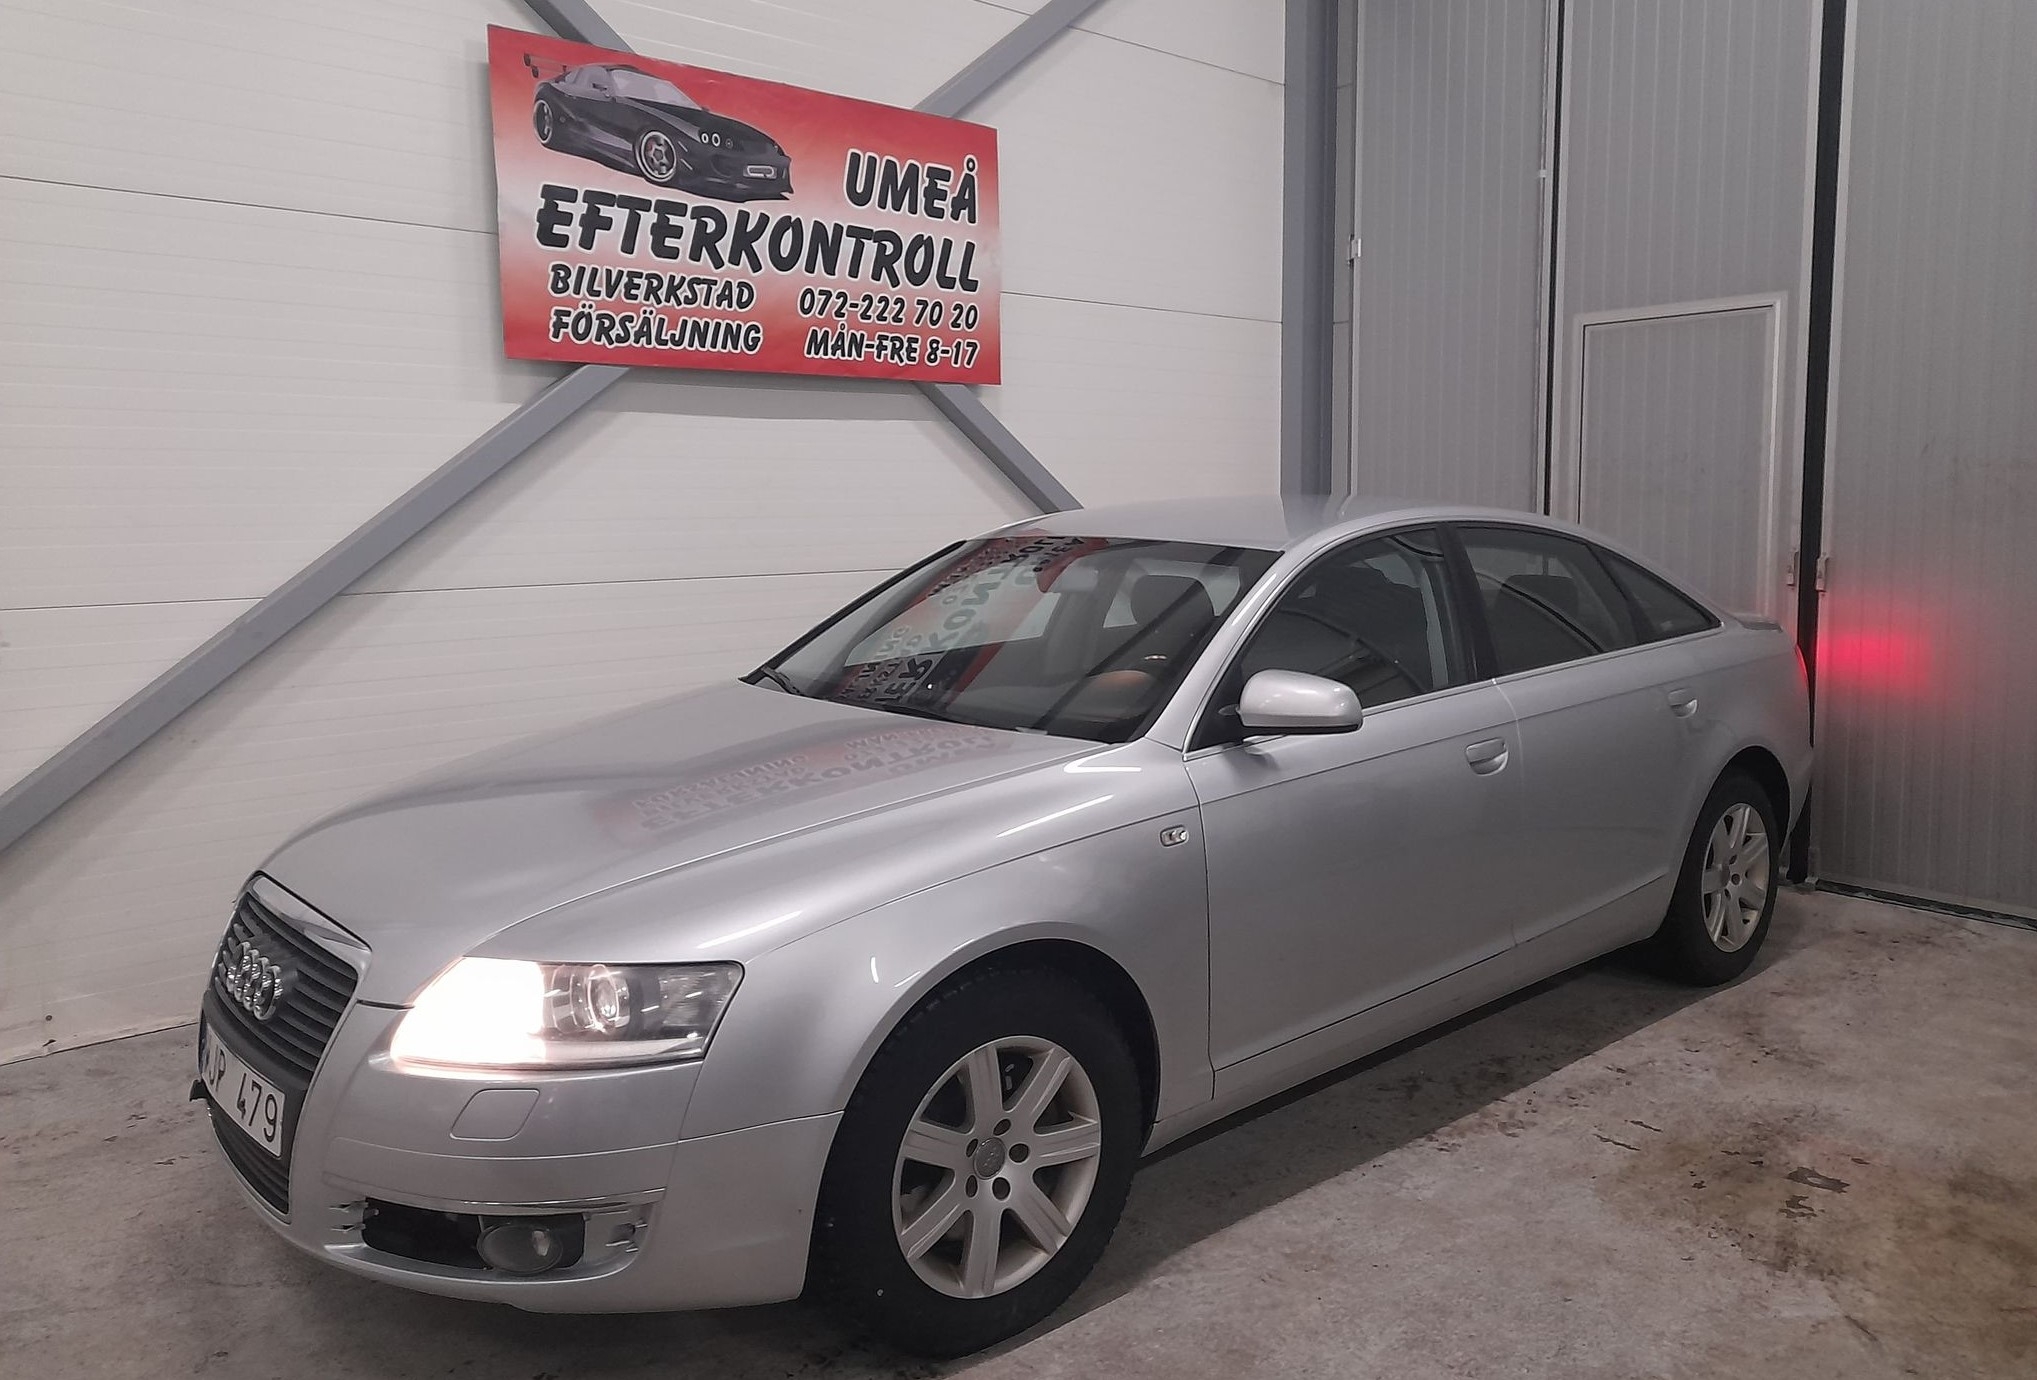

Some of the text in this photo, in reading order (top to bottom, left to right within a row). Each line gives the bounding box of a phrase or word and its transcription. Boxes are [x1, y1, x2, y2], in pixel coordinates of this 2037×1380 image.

[845, 151, 977, 224] UMEÅ
[536, 183, 979, 293] EFTERKONTROLL
[550, 263, 755, 310] BILVERKSTAD
[799, 287, 978, 330] 072-222 70 20
[551, 303, 761, 352] FÖRSÄLJNING
[806, 322, 978, 367] MÅN-FRE 8-17
[236, 1072, 278, 1143] 479
